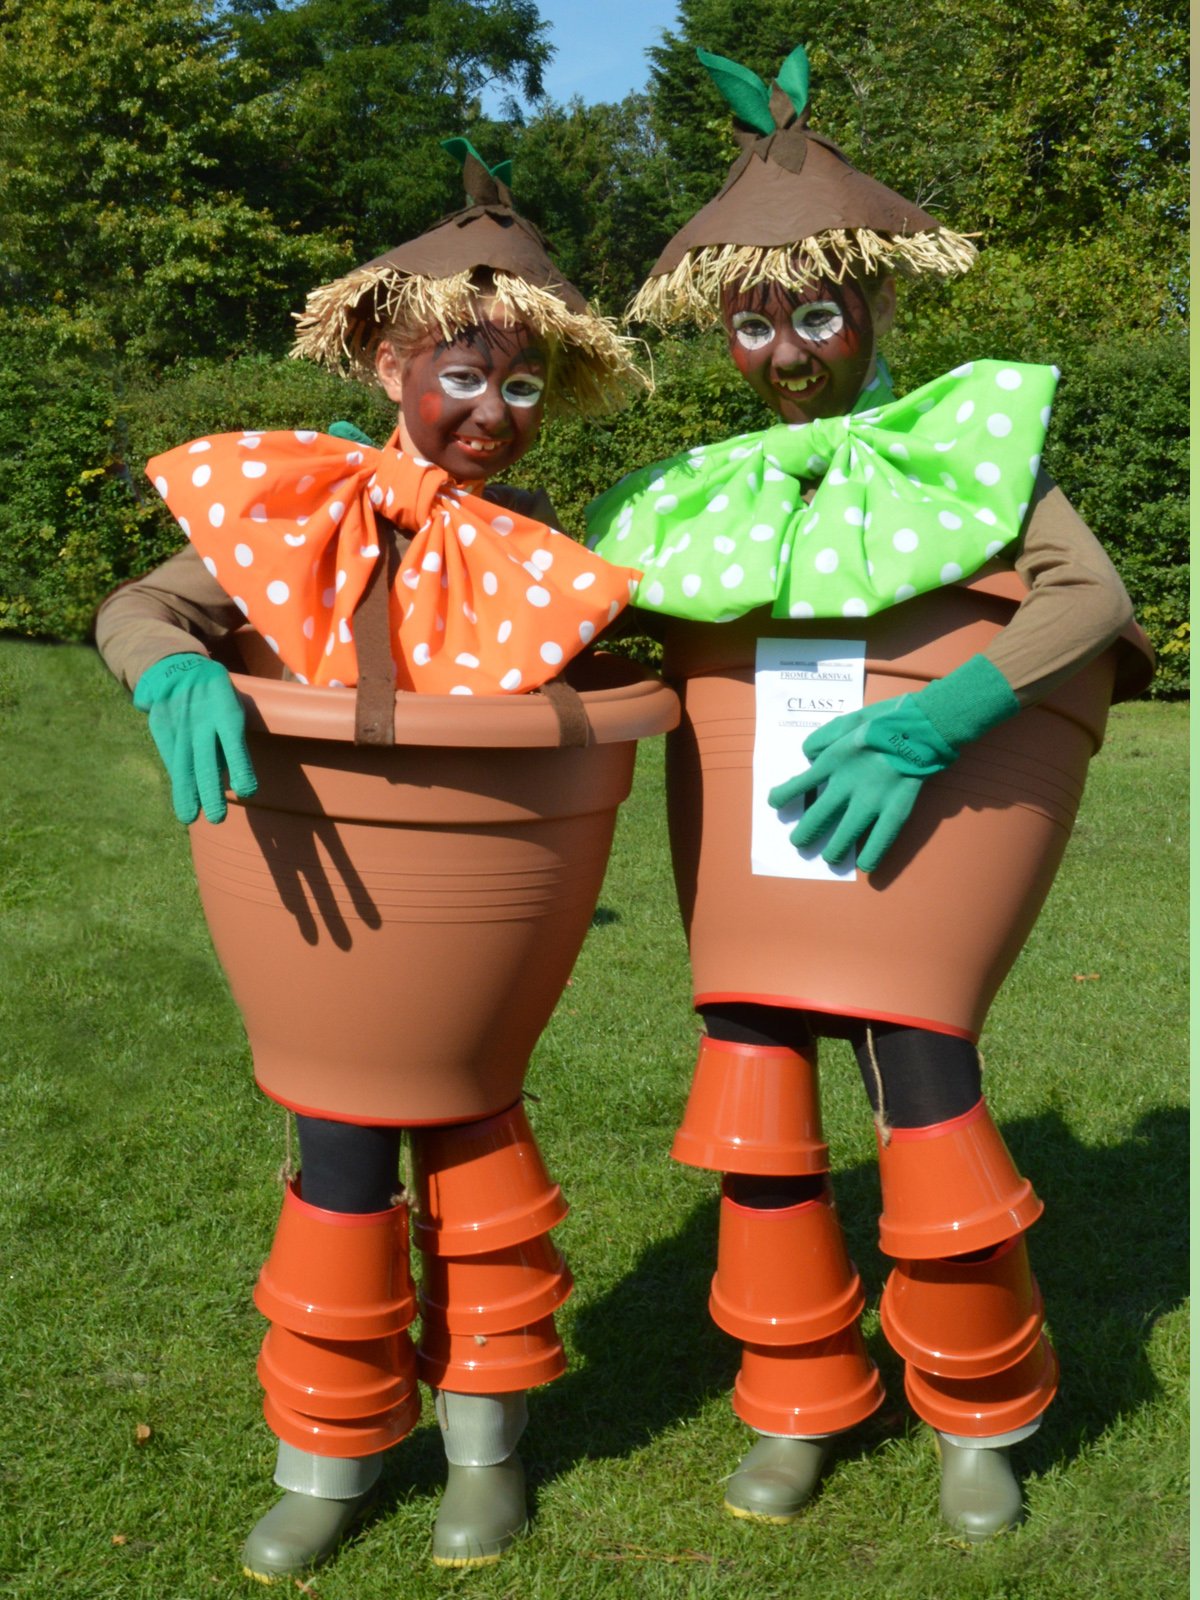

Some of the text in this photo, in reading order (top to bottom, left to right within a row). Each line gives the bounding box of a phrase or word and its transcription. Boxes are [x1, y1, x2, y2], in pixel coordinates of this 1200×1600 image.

[780, 671, 853, 681] FROME CARNIVAL
[787, 697, 845, 709] CLASS 7
